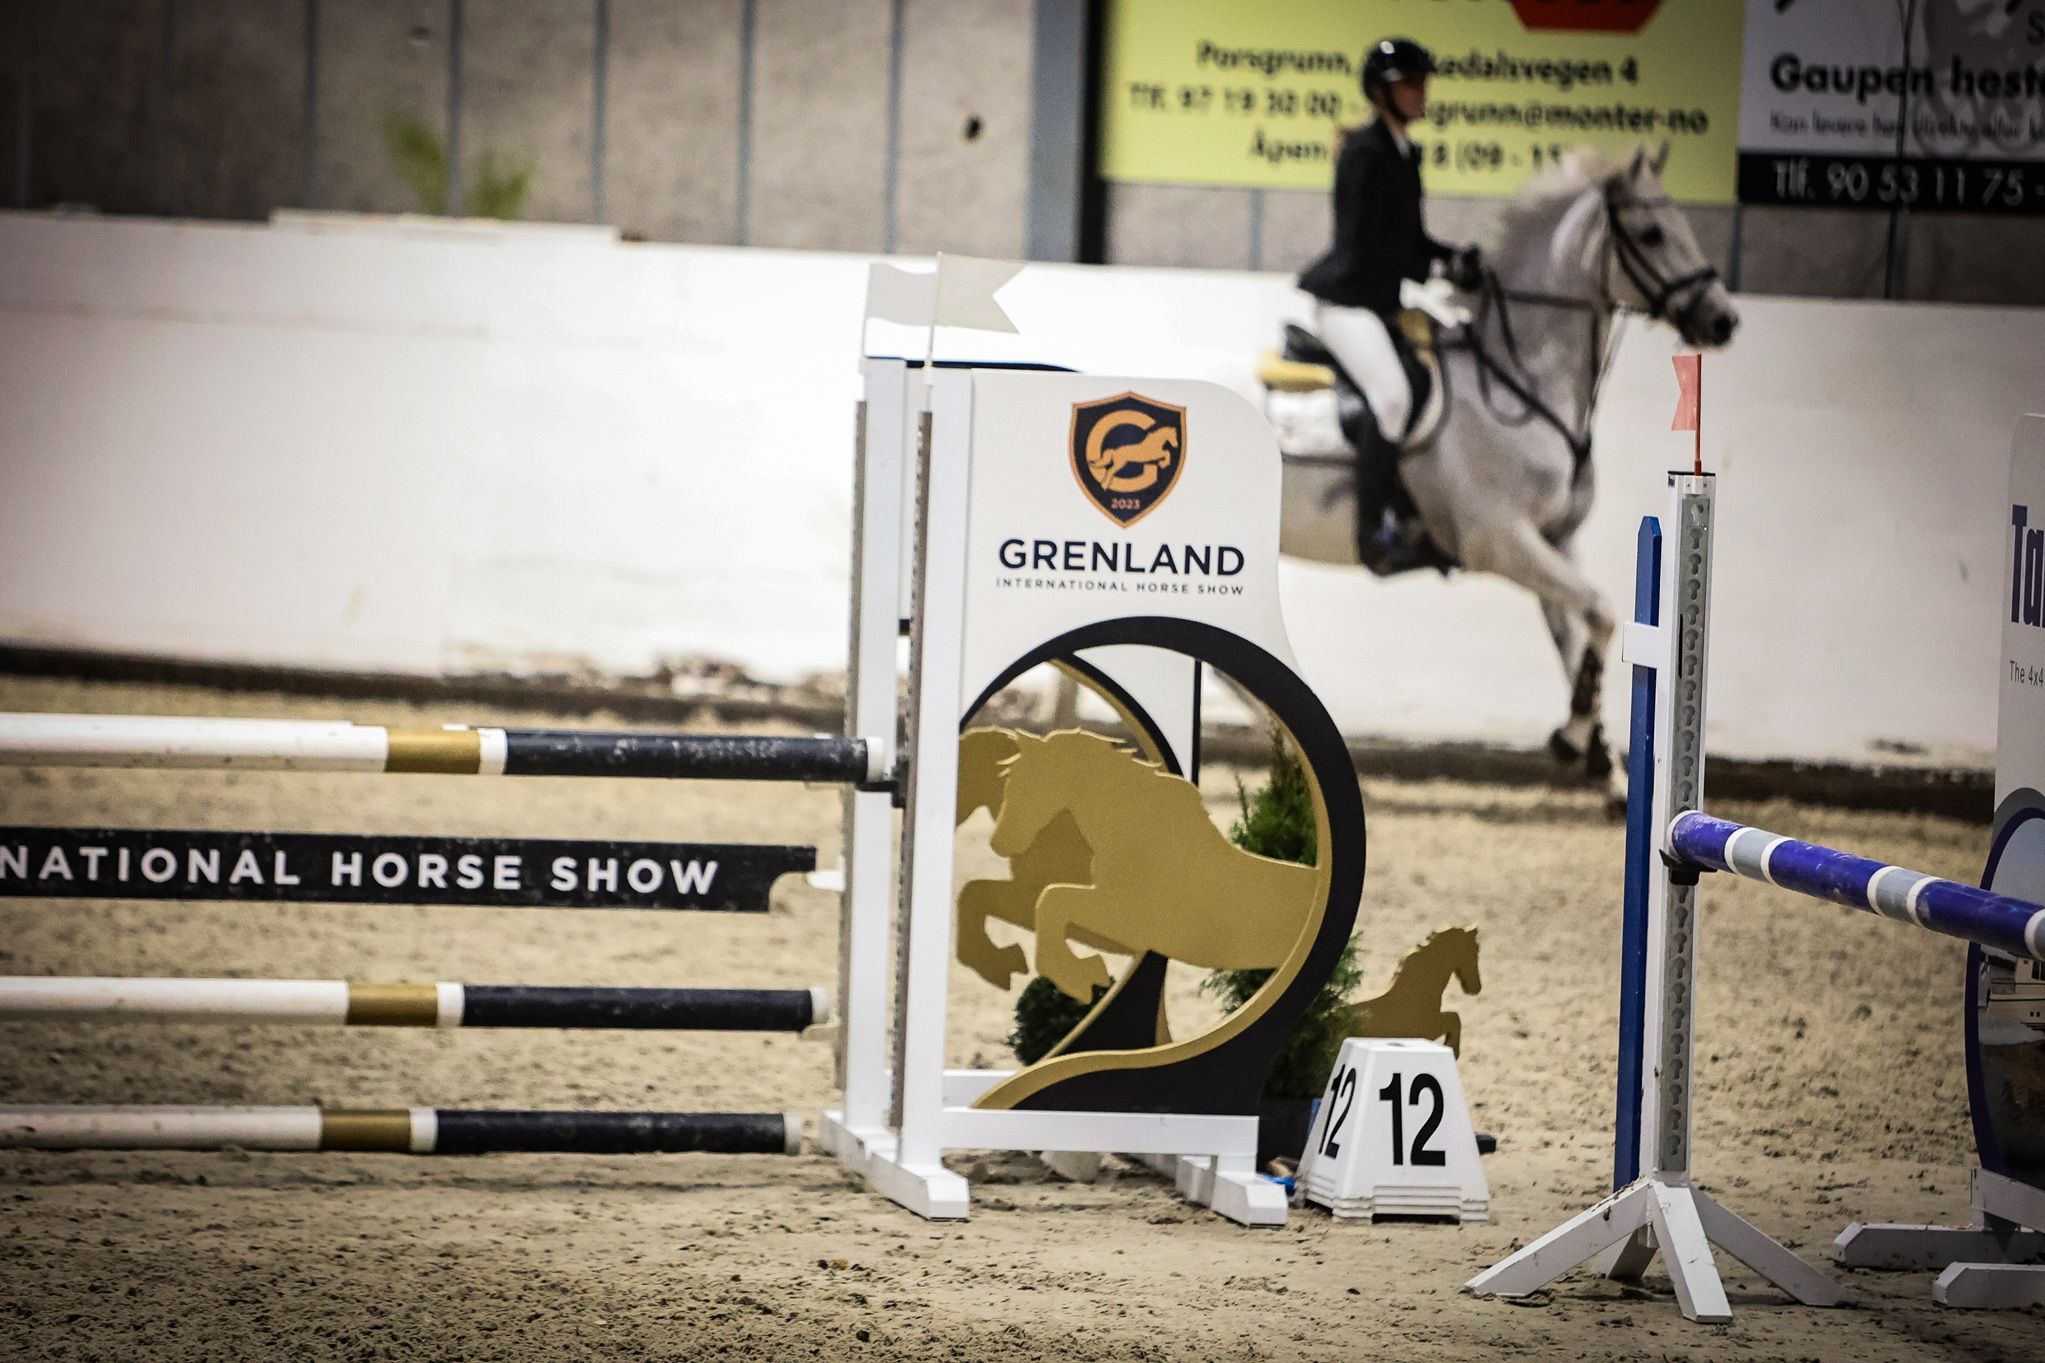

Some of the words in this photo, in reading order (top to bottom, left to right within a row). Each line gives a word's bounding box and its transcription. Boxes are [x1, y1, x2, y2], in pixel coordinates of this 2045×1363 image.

[1770, 53, 1934, 104] Gaupen
[1826, 161, 1869, 201] 90
[1877, 164, 1919, 202] 53
[1935, 166, 1966, 205] 11
[1981, 168, 2024, 206] 75
[1111, 498, 1141, 510] 2023
[999, 538, 1245, 577] GRENLAND
[2010, 504, 2045, 629] Ta
[996, 577, 1128, 593] INTERNATIONAL
[1136, 583, 1189, 595] HORSE
[1197, 585, 1245, 596] SHOW
[2009, 659, 2025, 684] The
[2028, 665, 2044, 688] 4x4
[0, 845, 300, 885] NATIONAL
[331, 851, 523, 891] HORSE
[550, 857, 719, 895] SHOW
[1318, 1064, 1357, 1160] 12
[1379, 1073, 1446, 1167] 12
